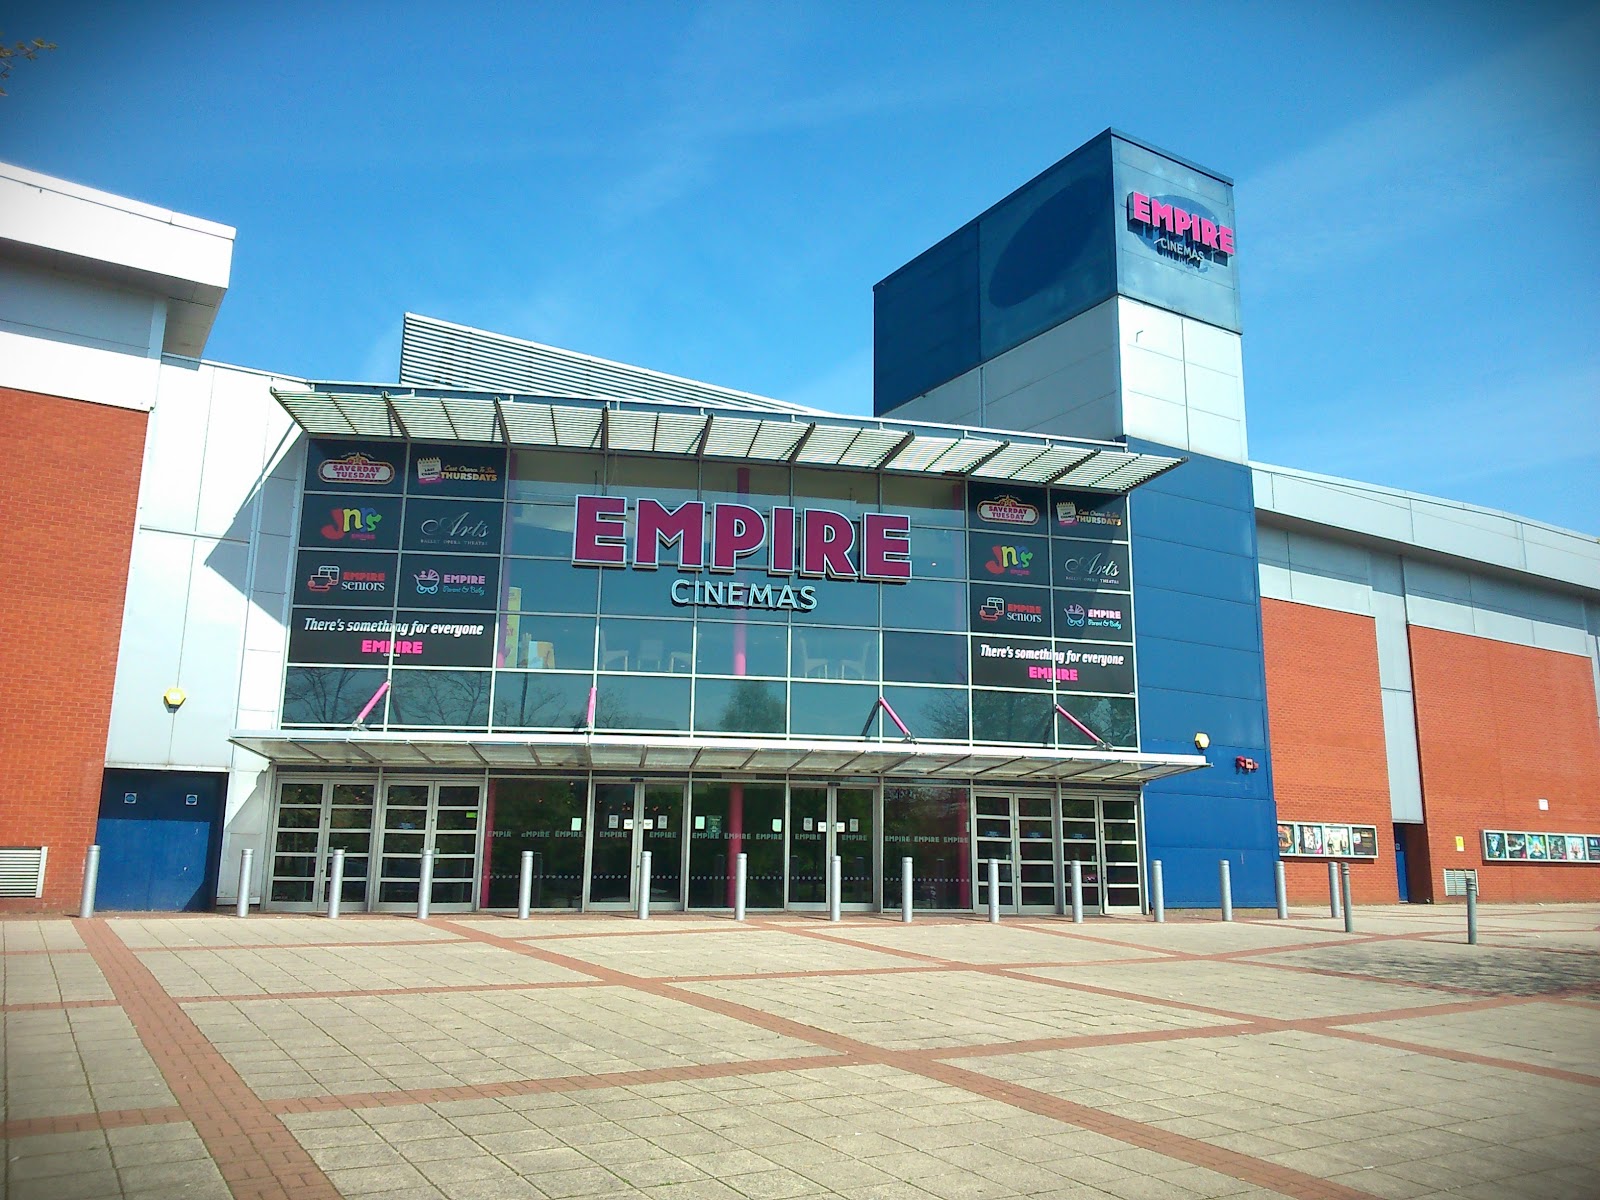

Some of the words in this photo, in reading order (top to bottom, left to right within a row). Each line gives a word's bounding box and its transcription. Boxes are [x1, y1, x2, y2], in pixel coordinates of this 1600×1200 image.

[1131, 191, 1235, 257] EMPIRE
[1160, 239, 1204, 261] CINEMAS
[332, 465, 381, 473] SAVERDAY
[441, 472, 498, 481] THURSDAYS
[988, 506, 1028, 514] SAVERDAY
[421, 512, 488, 537] Arts
[1076, 515, 1122, 526] THURSDAYS
[572, 494, 912, 582] EMPIRE
[1065, 553, 1119, 576] Arts
[343, 572, 385, 581] EMPIRE
[443, 575, 485, 584] EMPIRE
[341, 581, 385, 591] seniors
[671, 578, 818, 611] CINEMAS
[1008, 604, 1042, 613] EMPIRE
[1006, 612, 1042, 622] seniors
[1088, 609, 1121, 619] EMPIRE
[304, 618, 345, 631] There's
[346, 620, 410, 636] something
[408, 621, 430, 636] for
[431, 624, 484, 637] everyone
[981, 644, 1013, 658] There's
[1015, 648, 1065, 664] something
[1065, 650, 1081, 664] for
[1082, 653, 1124, 666] everyone
